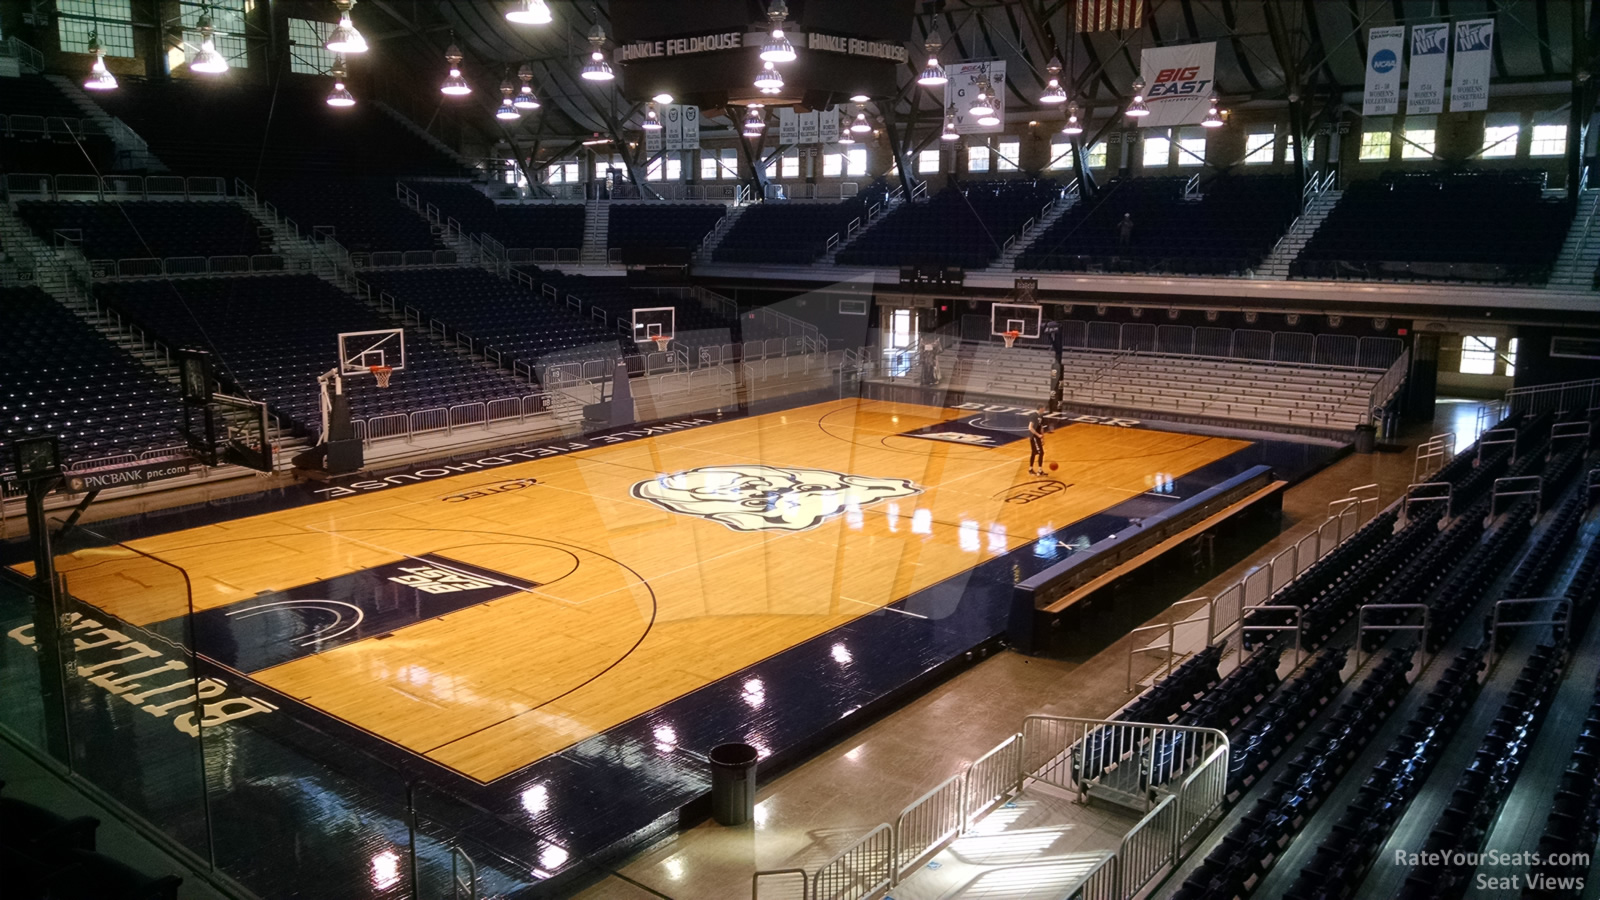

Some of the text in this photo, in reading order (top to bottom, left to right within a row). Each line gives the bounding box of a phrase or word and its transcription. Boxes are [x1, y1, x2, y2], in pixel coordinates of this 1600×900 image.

[622, 32, 742, 60] HINKLE FIELDHOUSE
[808, 32, 905, 62] HINKLE FIELDHOUSE
[1374, 60, 1396, 69] NCAA
[1154, 66, 1201, 83] BIG
[957, 88, 966, 97] G
[1148, 80, 1212, 97] EAST
[314, 418, 713, 499] HINKLE FIELDHOUSE
[146, 465, 186, 480] pnc.com
[387, 574, 463, 595] BIG
[397, 565, 494, 591] EAST
